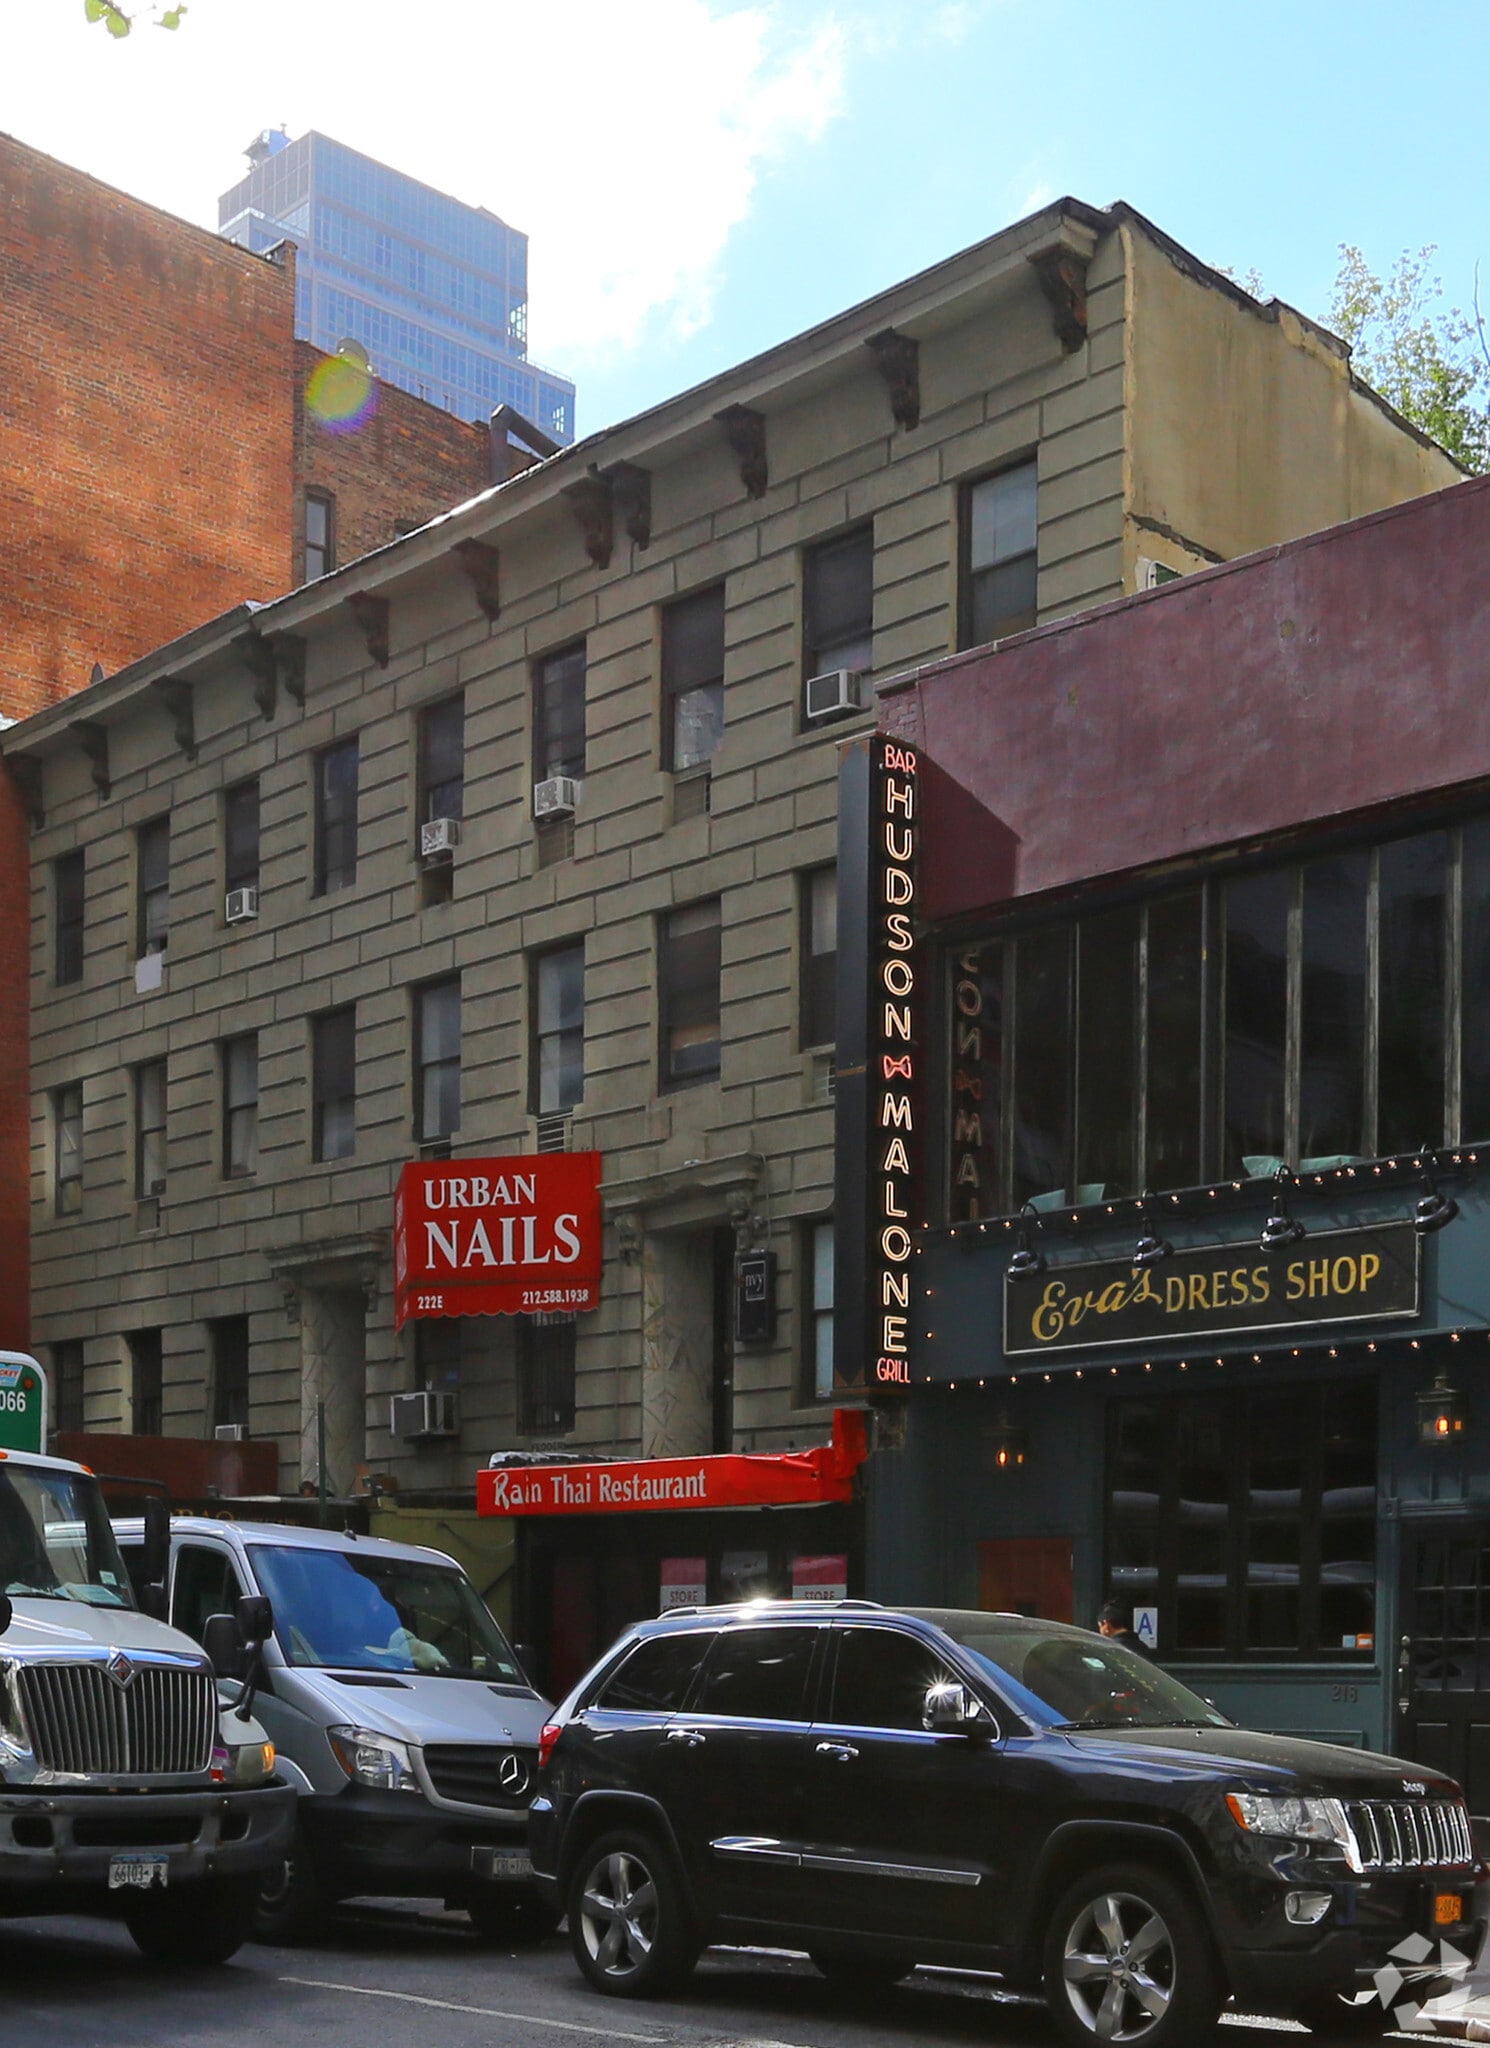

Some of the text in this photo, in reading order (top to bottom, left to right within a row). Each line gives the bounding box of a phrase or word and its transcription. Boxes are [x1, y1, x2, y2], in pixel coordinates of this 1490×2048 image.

[885, 744, 916, 774] BAR
[884, 778, 914, 1041] HUDSON
[424, 1174, 536, 1210] URBAN
[881, 1092, 913, 1353] MALONE
[424, 1213, 581, 1270] NAILS
[417, 1288, 590, 1310] 222E 212.588.1938
[1031, 1253, 1381, 1342] Eva's DRESS SHOP
[877, 1357, 912, 1384] GRILL
[493, 1468, 707, 1511] Rain Thai Restaurant
[669, 1590, 699, 1603] STORE
[803, 1590, 836, 1601] STORE
[1138, 1612, 1153, 1635] A
